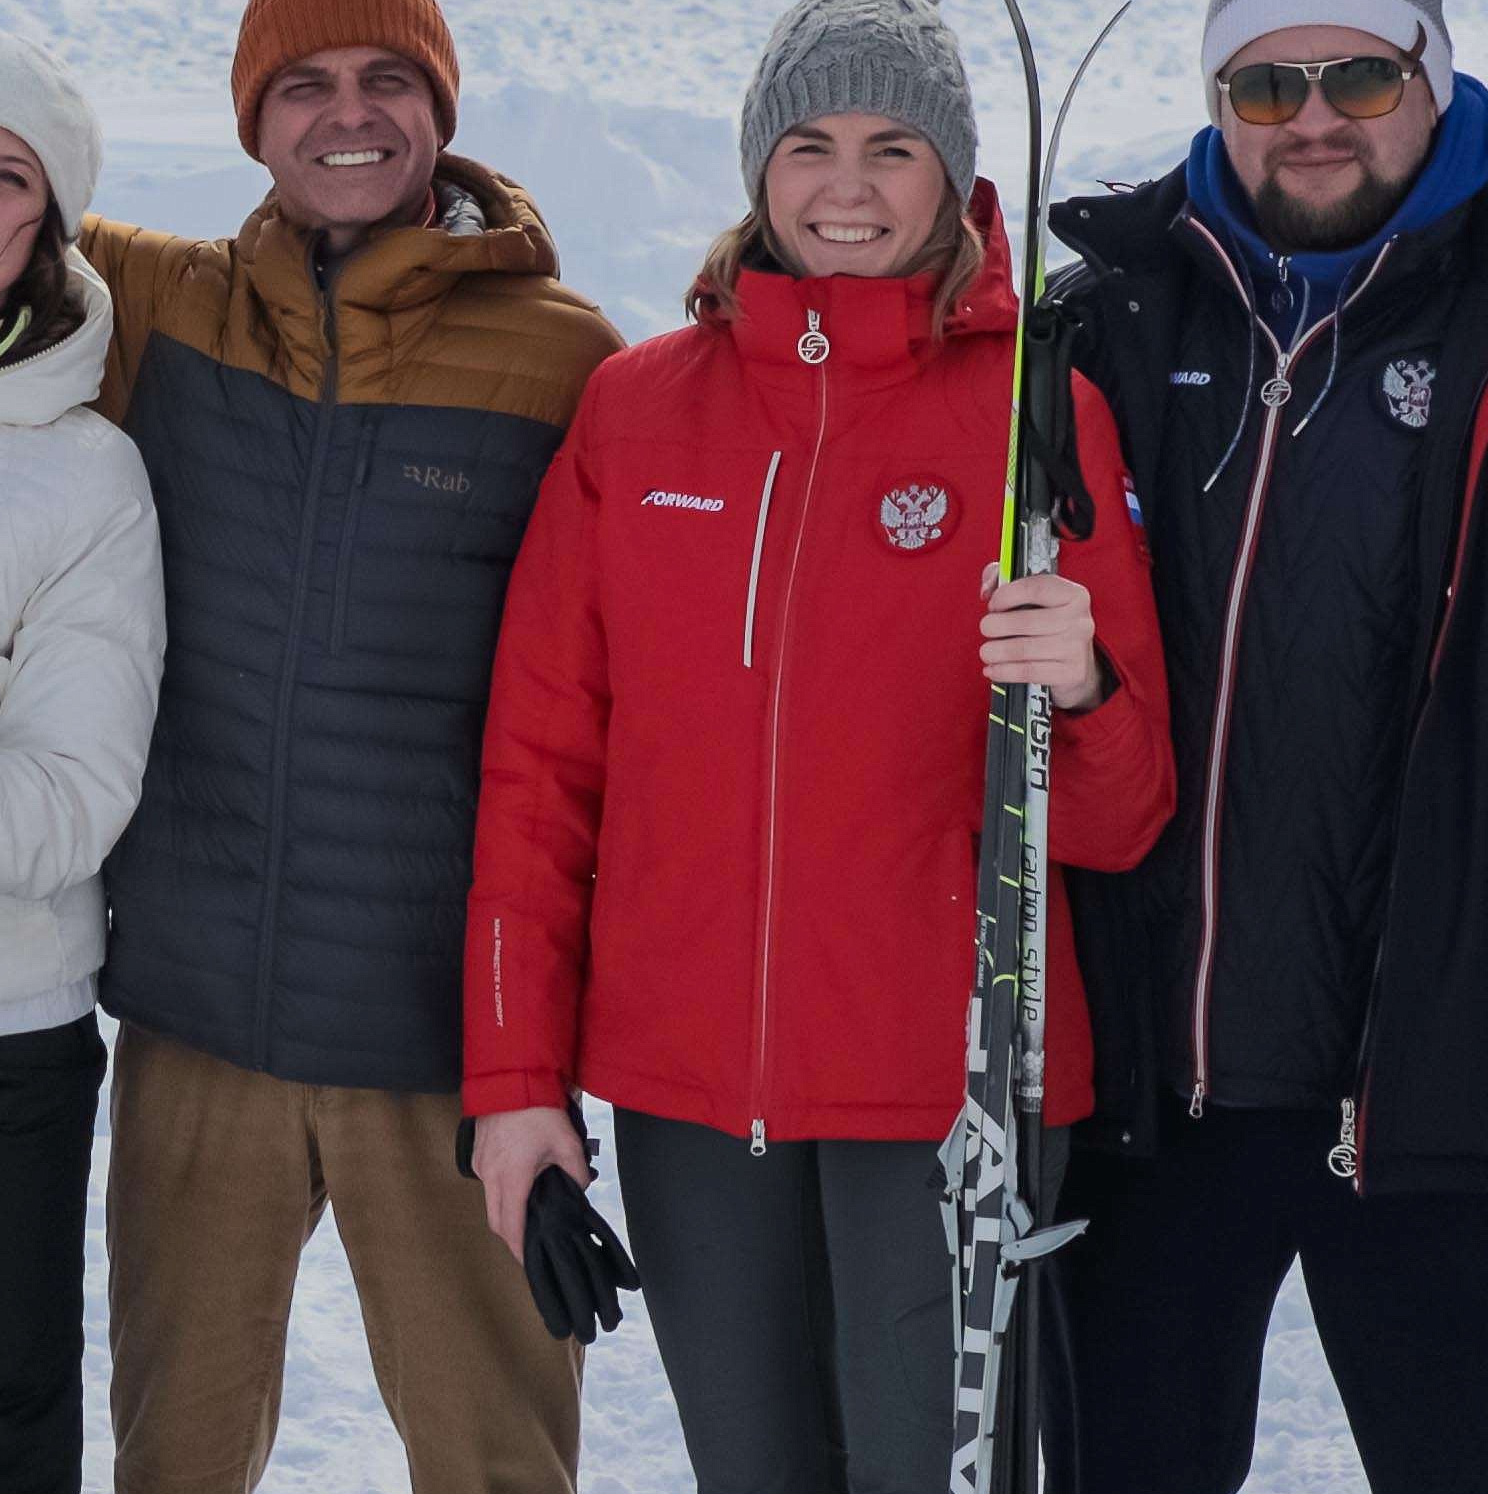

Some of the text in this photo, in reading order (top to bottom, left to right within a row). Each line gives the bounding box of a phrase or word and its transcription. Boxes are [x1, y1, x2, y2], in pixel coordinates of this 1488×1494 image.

[1169, 371, 1212, 388] WARD
[424, 464, 472, 494] Rab
[641, 489, 724, 513] FORWARD
